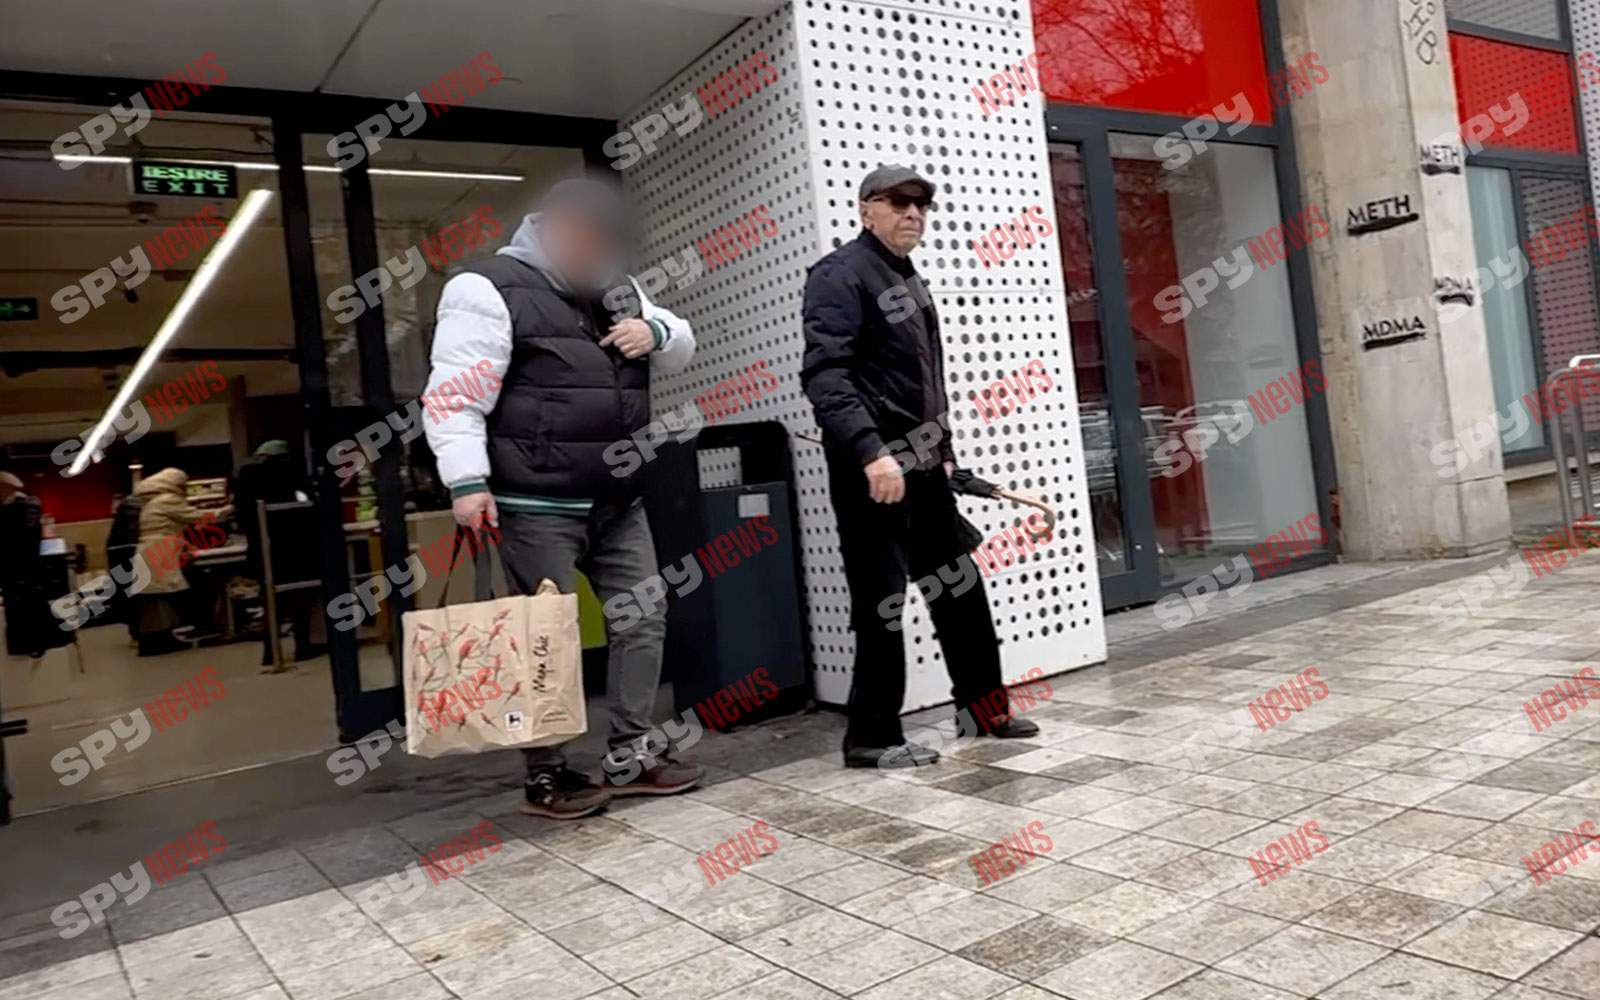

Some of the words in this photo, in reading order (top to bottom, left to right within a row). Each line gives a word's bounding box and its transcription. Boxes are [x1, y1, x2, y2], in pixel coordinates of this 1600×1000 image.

[141, 180, 229, 195] EXIT
[1347, 194, 1411, 226] METH
[1363, 316, 1427, 340] MDMA
